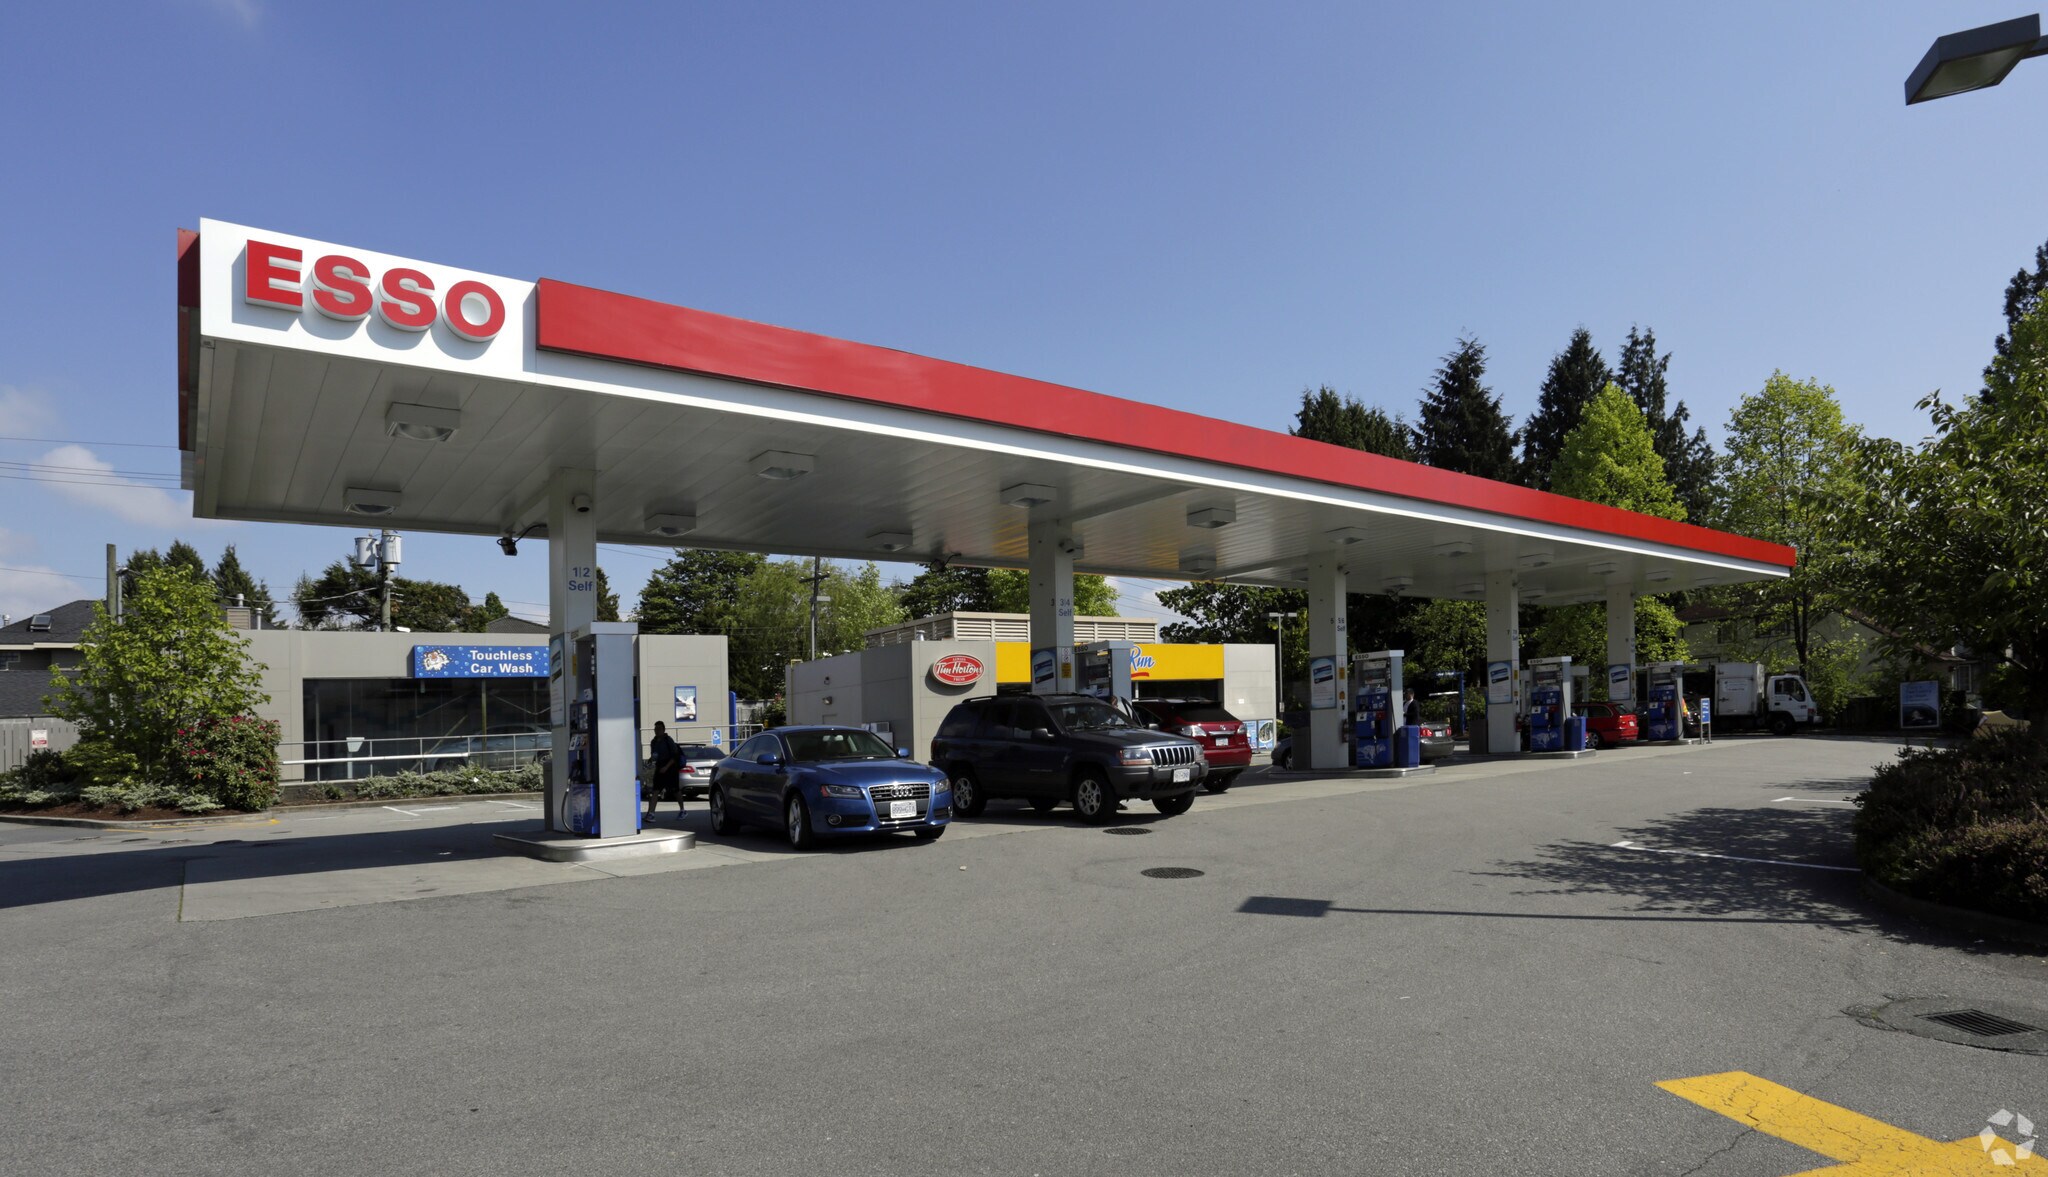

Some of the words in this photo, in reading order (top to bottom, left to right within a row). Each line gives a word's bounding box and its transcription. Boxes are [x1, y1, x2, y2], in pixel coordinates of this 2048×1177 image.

[246, 240, 505, 341] ESSO
[568, 580, 593, 592] Self
[1058, 608, 1072, 617] Self
[470, 650, 533, 661] Touchless
[1130, 646, 1156, 671] Run
[470, 663, 493, 674] Car
[499, 663, 533, 674] Wash
[936, 662, 951, 675] Tim
[952, 661, 983, 675] Hortons
